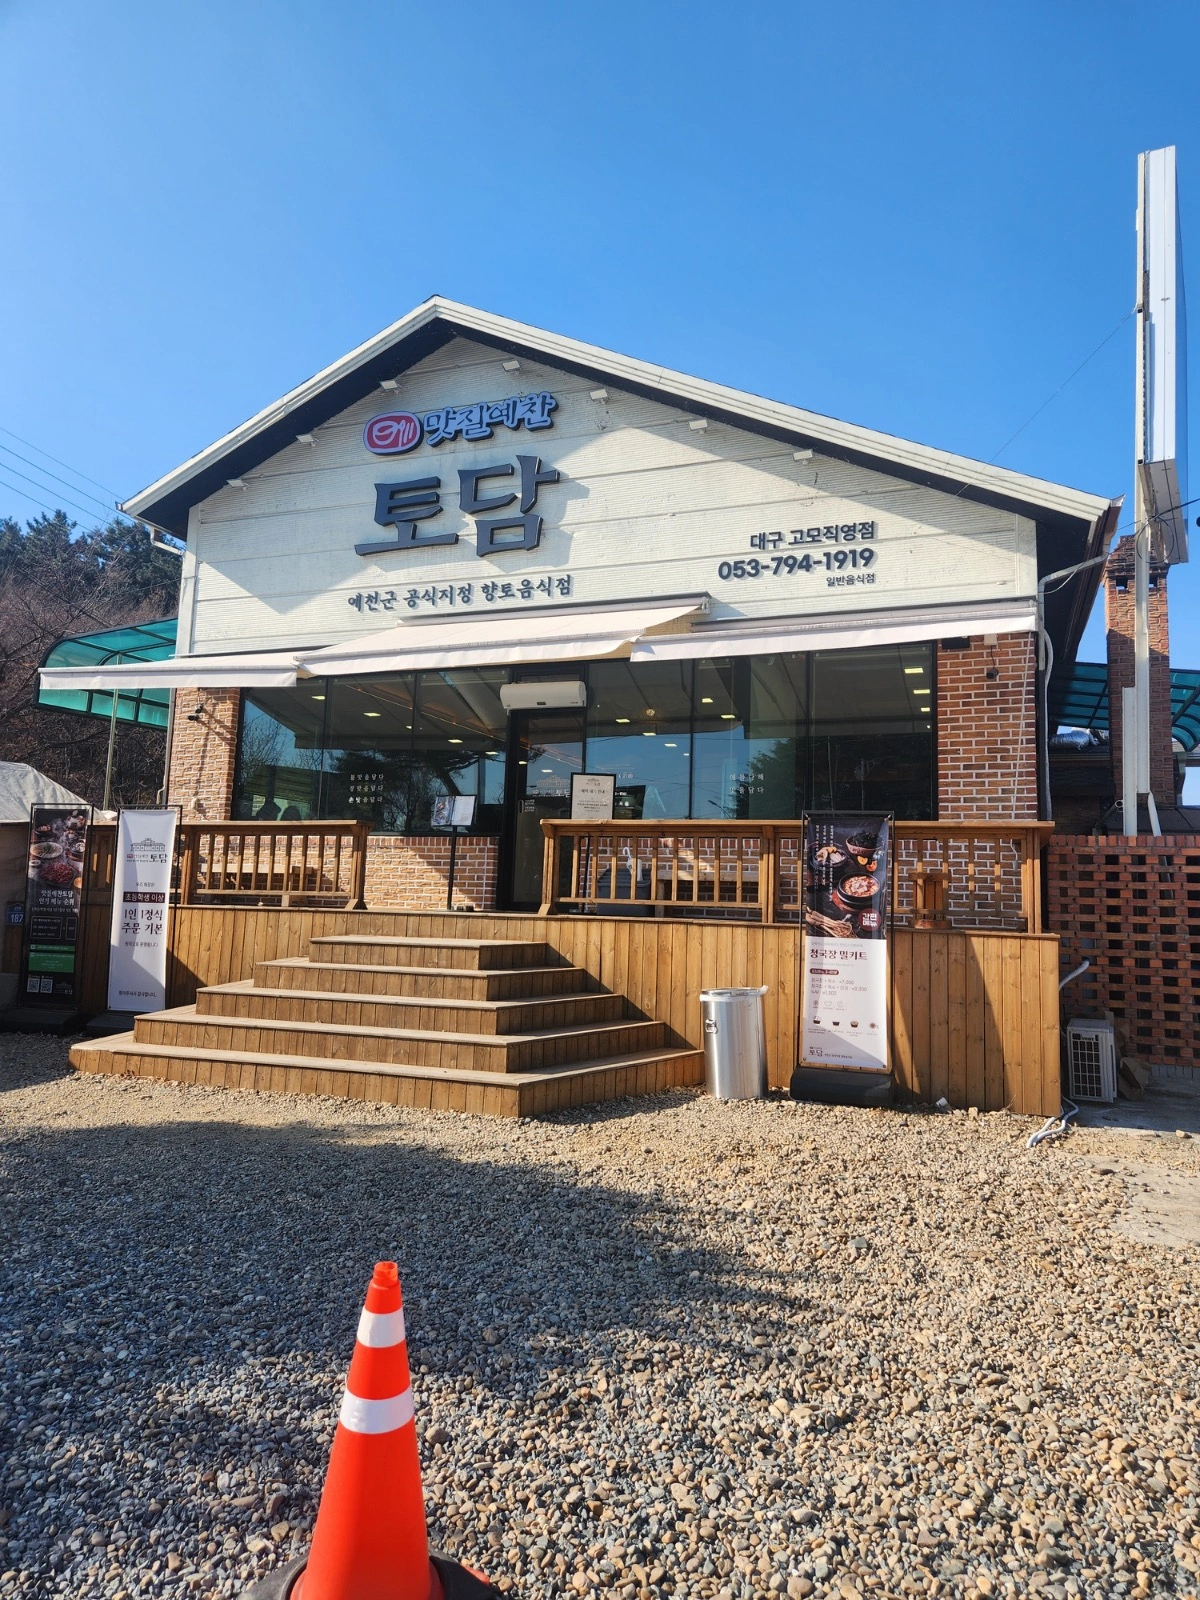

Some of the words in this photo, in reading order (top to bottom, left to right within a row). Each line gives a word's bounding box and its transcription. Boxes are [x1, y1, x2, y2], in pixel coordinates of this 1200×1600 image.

[354, 455, 560, 557] 토담
[751, 532, 783, 550] 대구
[788, 521, 875, 545] 고모직영점
[718, 548, 875, 580] 053-794-1919
[826, 573, 875, 587] 일반음식점
[348, 590, 397, 612] 예천군
[403, 583, 472, 608] 공식지정
[481, 575, 571, 601] 향토음식점
[150, 853, 168, 863] 토담
[125, 893, 150, 902] 초등학생
[151, 893, 165, 902] 이상
[11, 914, 24, 923] 187
[862, 913, 877, 921] 간편
[122, 922, 141, 934] 주문
[144, 923, 163, 935] 기본
[810, 949, 837, 959] 청국장
[839, 950, 868, 961] 밀키트
